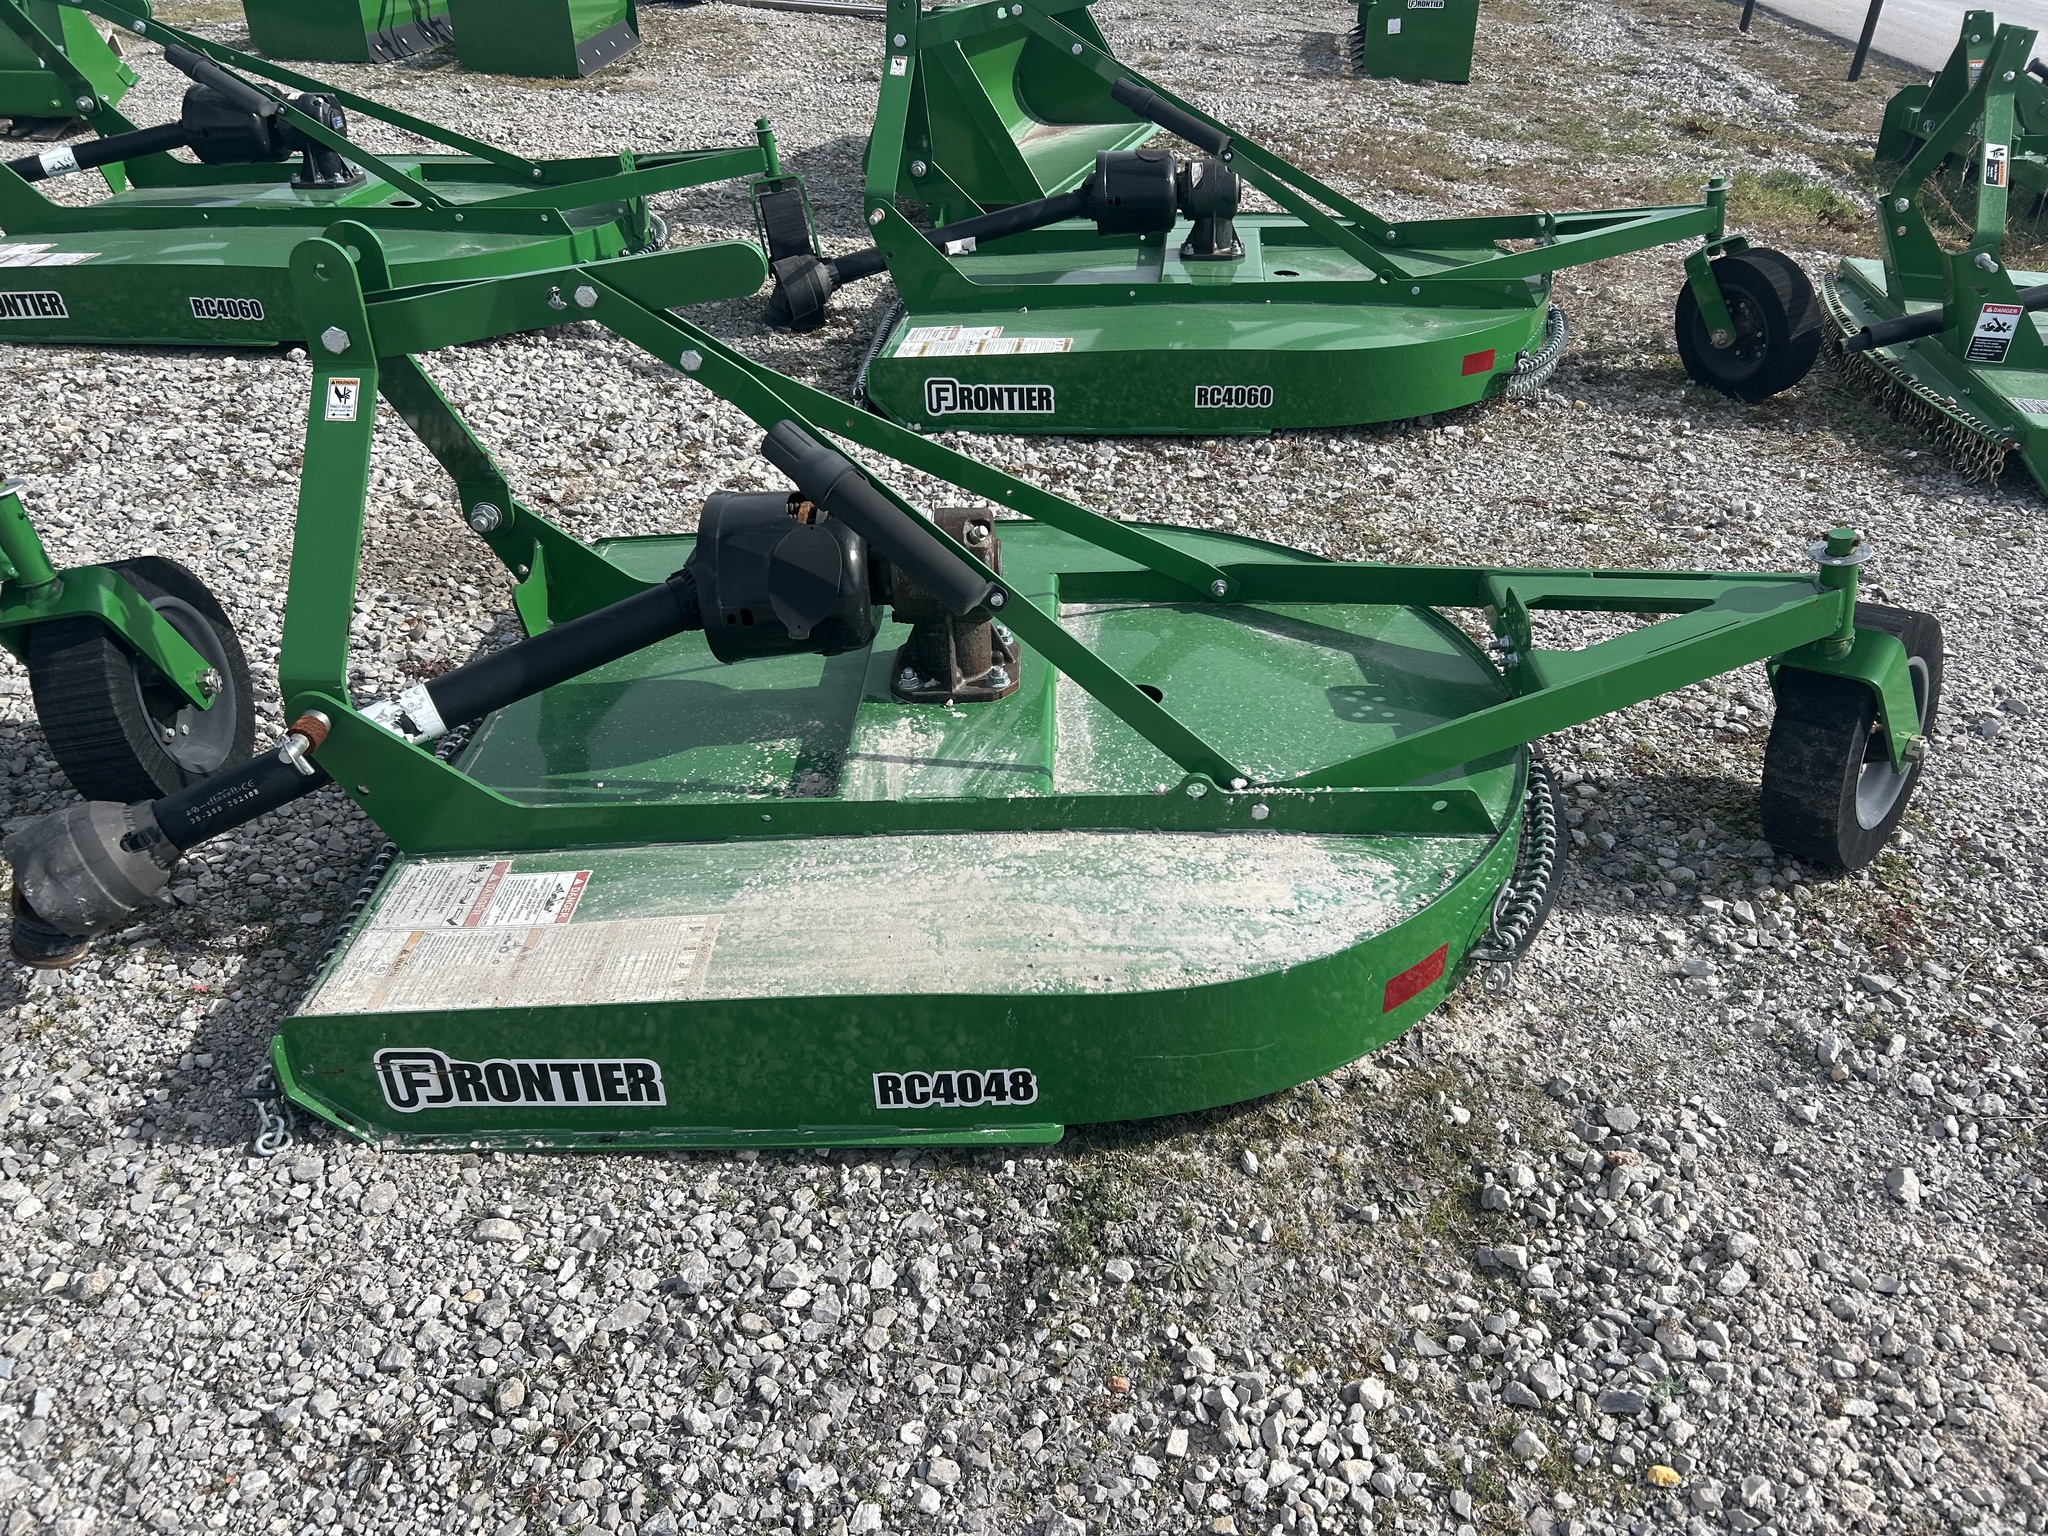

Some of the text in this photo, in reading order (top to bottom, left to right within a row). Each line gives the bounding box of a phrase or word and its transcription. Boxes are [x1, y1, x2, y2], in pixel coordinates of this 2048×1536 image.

[1408, 0, 1444, 8] FRONTIER
[191, 298, 263, 319] RC4060
[926, 379, 1053, 414] FRONTIER
[1196, 387, 1272, 406] RC4060
[471, 883, 496, 916] DANGER
[561, 887, 581, 918] DANGER
[379, 1051, 661, 1108] FRONTIER
[877, 1070, 1034, 1105] RC4048
